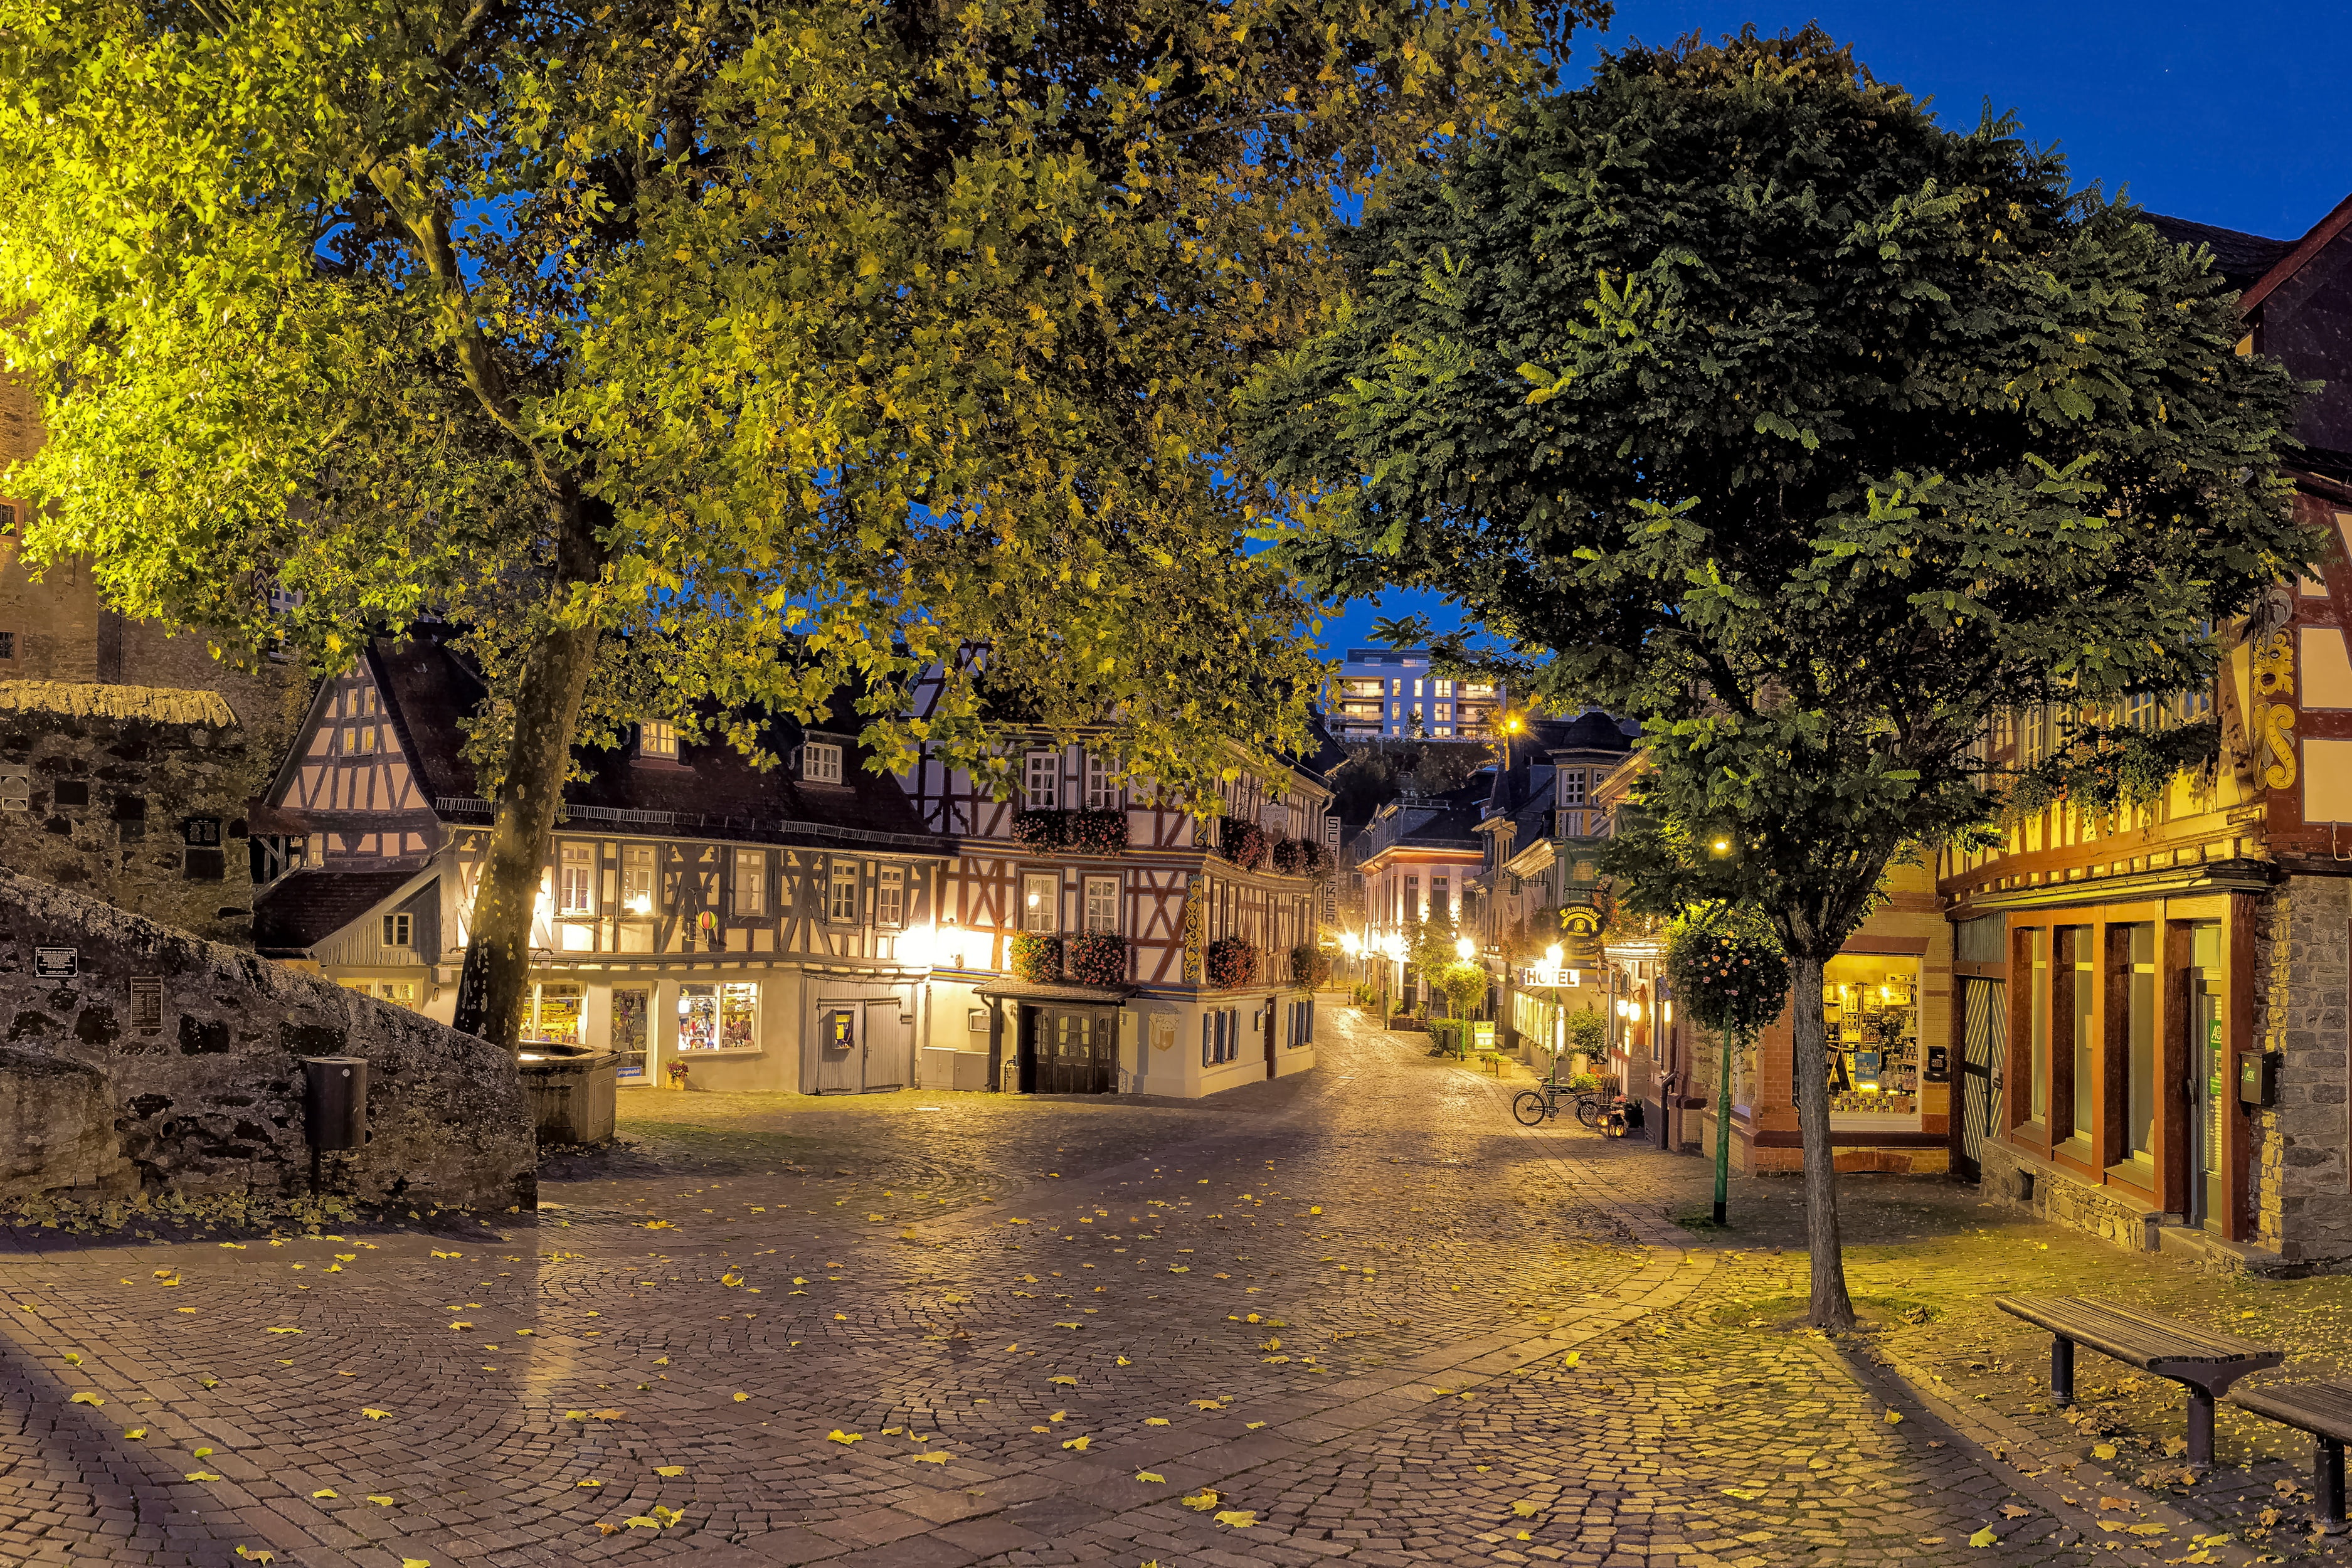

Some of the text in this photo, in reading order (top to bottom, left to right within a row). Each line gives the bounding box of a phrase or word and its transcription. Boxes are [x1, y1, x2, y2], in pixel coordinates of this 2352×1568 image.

[1559, 906, 1602, 921] Taunushof
[1527, 970, 1576, 985] HOTEL
[2211, 1025, 2222, 1039] AO
[618, 1068, 640, 1076] playmobil
[2245, 1070, 2255, 1079] AOK
